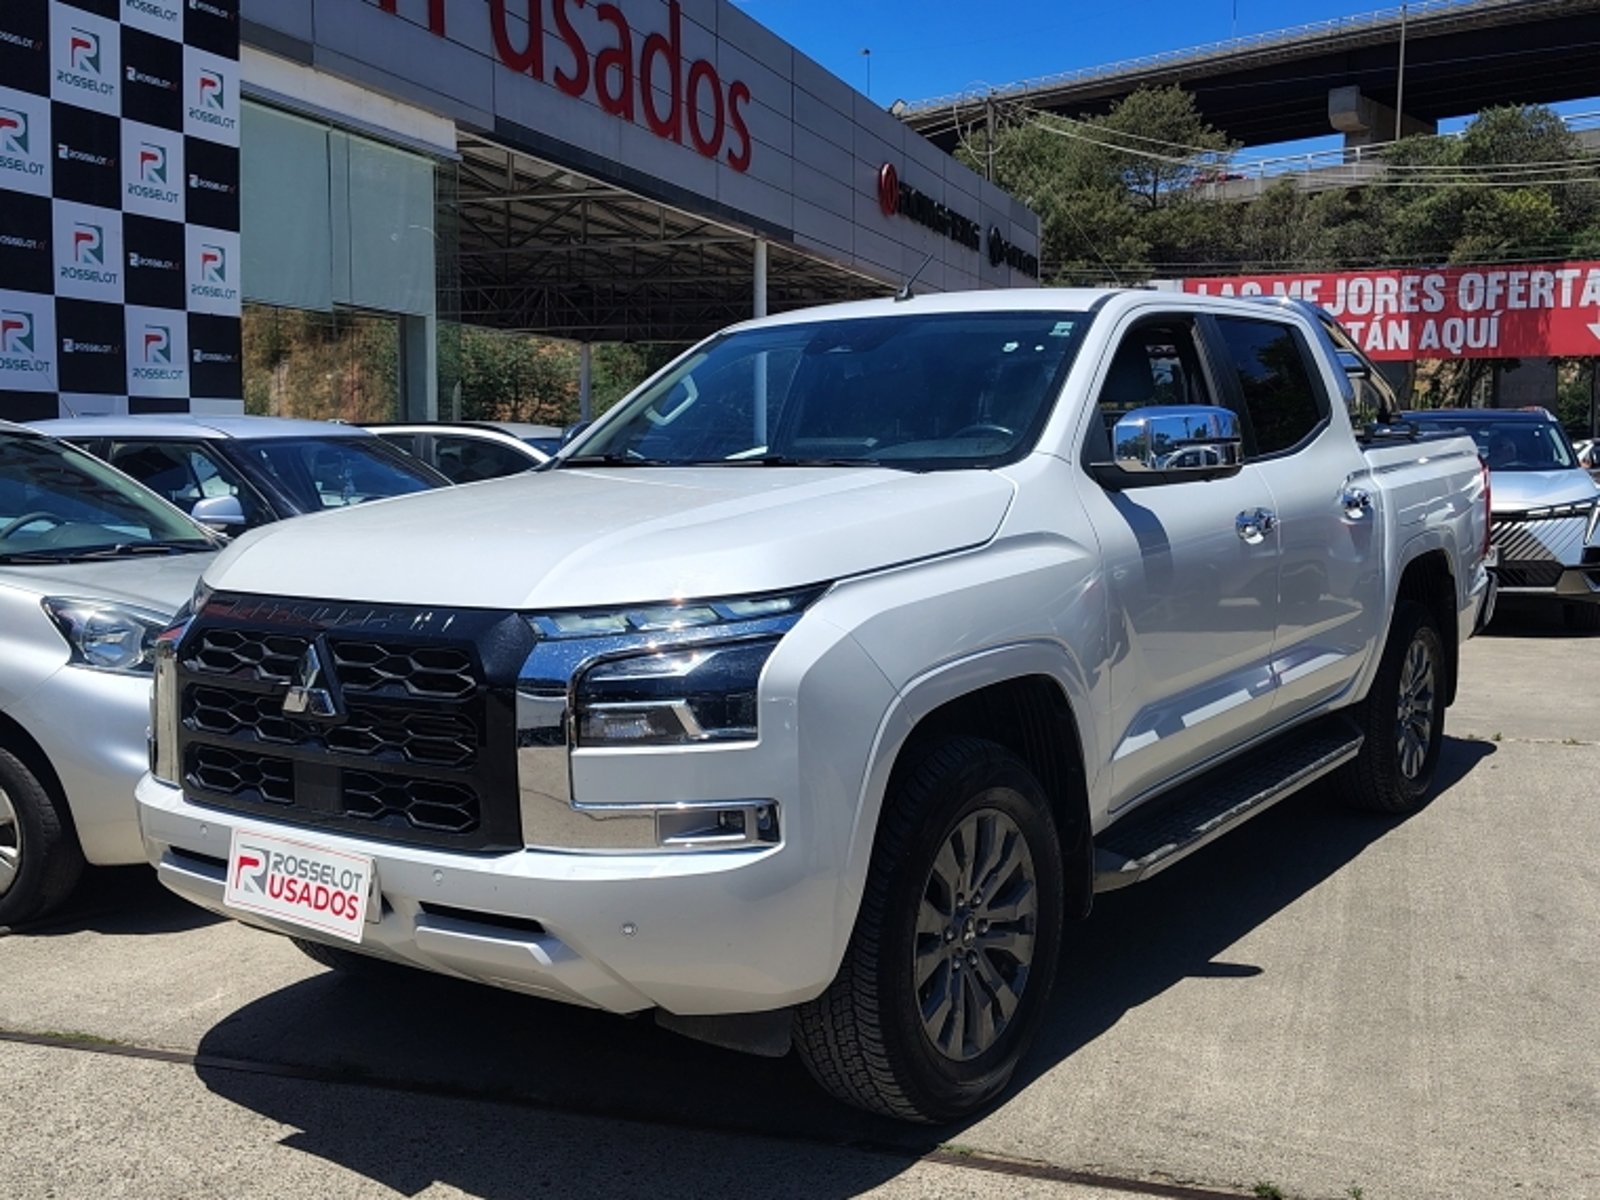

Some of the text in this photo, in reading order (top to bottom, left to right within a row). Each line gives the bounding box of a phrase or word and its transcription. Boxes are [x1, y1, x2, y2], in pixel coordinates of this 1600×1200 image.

[57, 69, 114, 96] ROSSELOT
[489, 0, 750, 173] usados
[188, 106, 236, 130] ROSSELOT
[0, 157, 44, 176] SSELOT
[127, 183, 179, 203] ROSSELOT
[60, 266, 118, 285] ROSSELOT
[191, 283, 237, 299] ROSSELOT
[1458, 268, 1600, 311] OFERTA
[1340, 309, 1503, 354] TÁN AQUÍ
[0, 357, 50, 373] OSSELOT
[132, 367, 184, 380] ROSSELOT
[271, 852, 363, 893] ROSSELOT
[268, 874, 359, 921] USADOS
